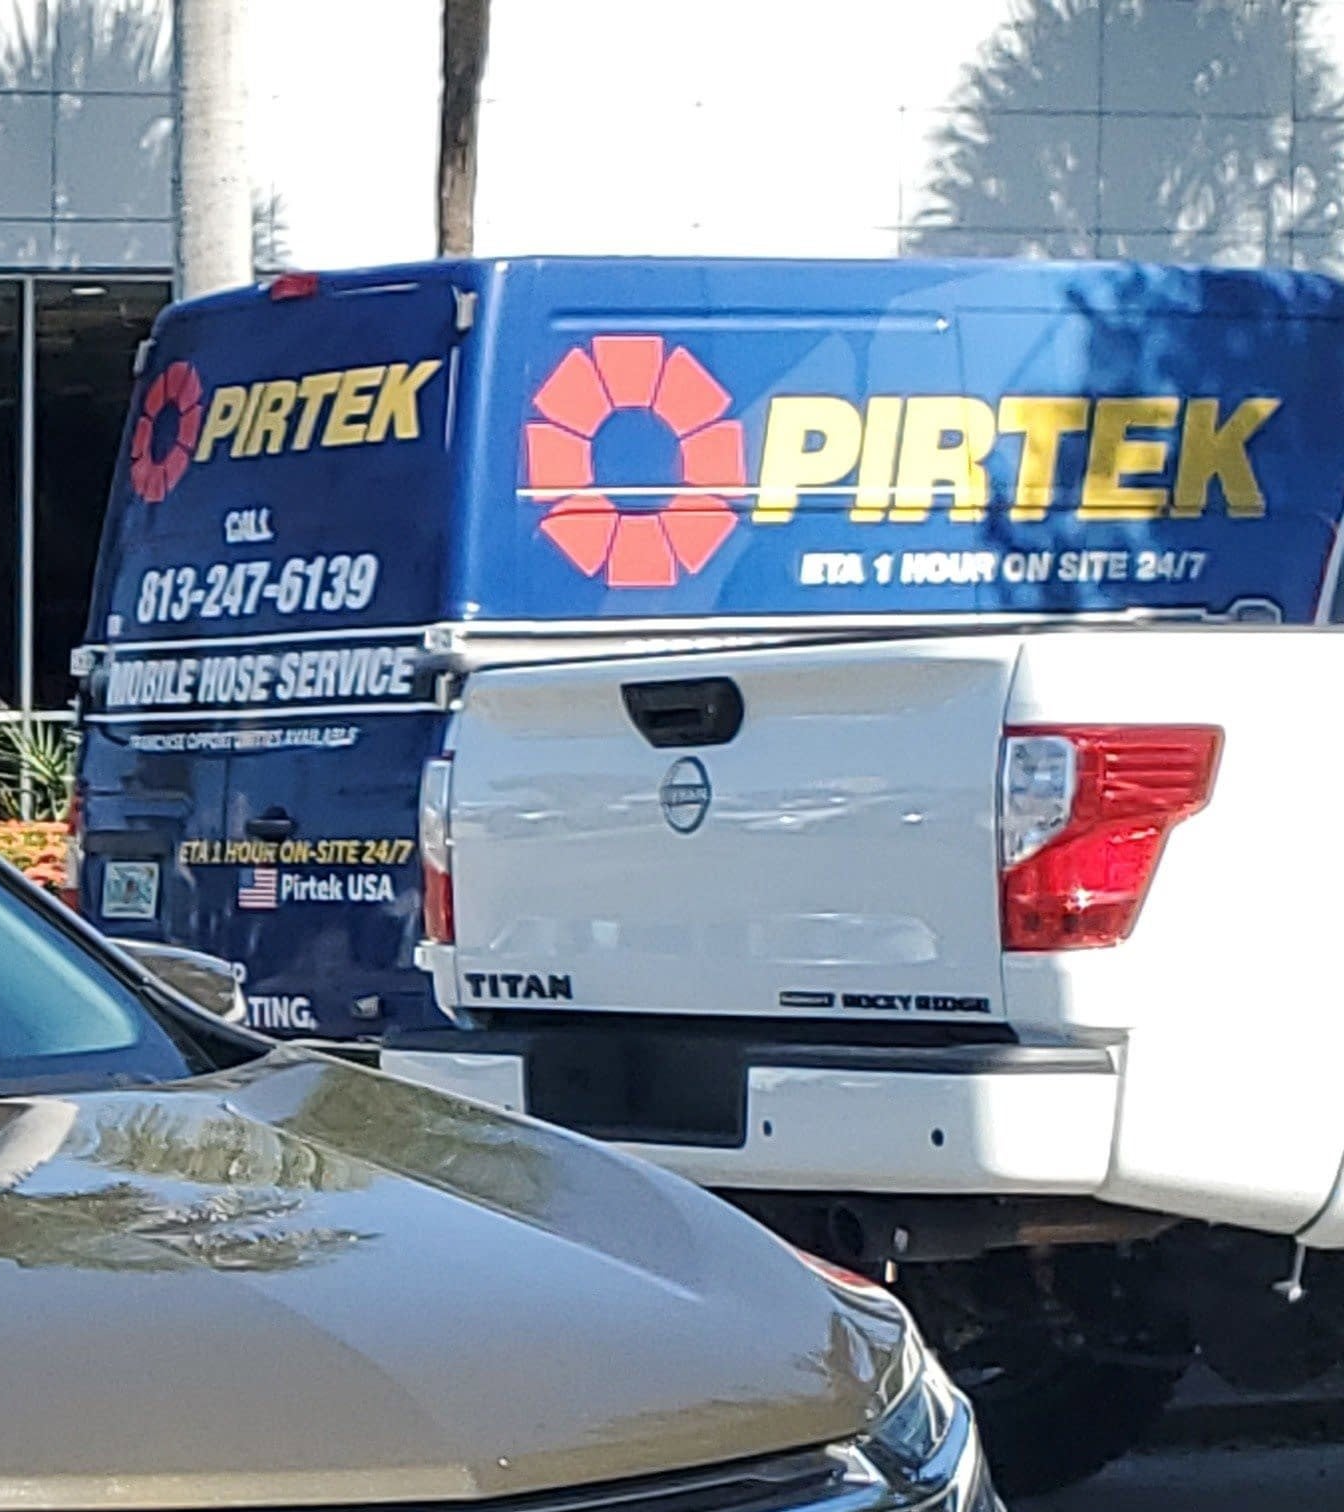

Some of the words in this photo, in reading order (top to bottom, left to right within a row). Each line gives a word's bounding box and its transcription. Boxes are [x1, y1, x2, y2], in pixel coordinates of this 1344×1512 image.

[194, 359, 442, 462] PIRTEK
[750, 396, 1282, 525] PIRTEK
[224, 507, 274, 543] CALL
[799, 551, 865, 585] ETA
[872, 553, 892, 584] 1
[900, 551, 997, 584] HOUR
[1003, 551, 1054, 583] ON
[1058, 550, 1127, 582] SITE
[1134, 550, 1206, 580] 24/7
[137, 554, 378, 624] 813-247-6139
[107, 658, 199, 707] MOBILE
[198, 653, 275, 703] HOSE
[276, 646, 417, 700] SERVICE
[179, 840, 209, 864] ETA
[224, 840, 278, 864] HOUR
[279, 839, 361, 864] ON-SITE
[361, 839, 414, 864] 24/7
[281, 873, 344, 901] Pirtek
[347, 873, 395, 902] USA
[464, 972, 574, 1000] TITAN
[244, 995, 318, 1030] TING.
